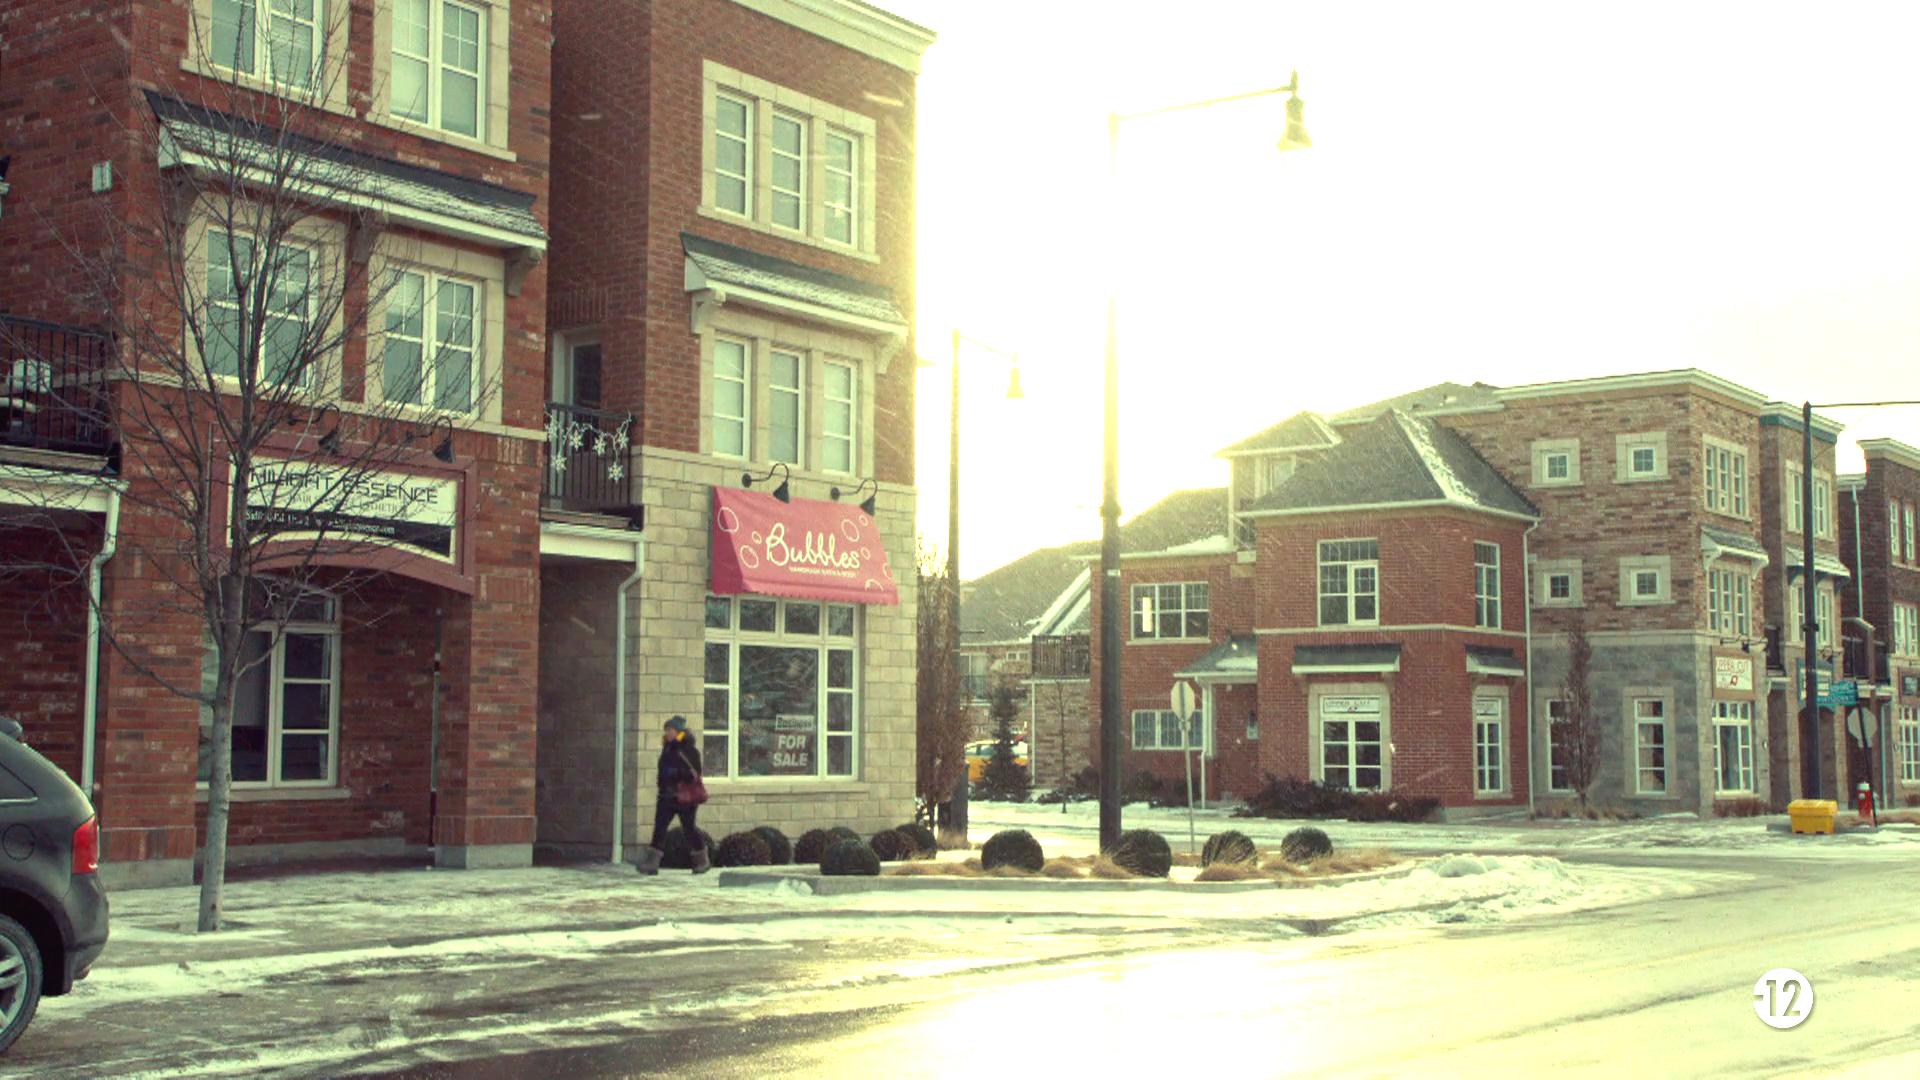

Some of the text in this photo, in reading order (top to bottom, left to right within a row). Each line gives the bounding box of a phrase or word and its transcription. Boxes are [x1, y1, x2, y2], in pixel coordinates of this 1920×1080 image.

[765, 522, 861, 569] Bubbles
[778, 735, 806, 749] FOR
[772, 752, 808, 767] SALE
